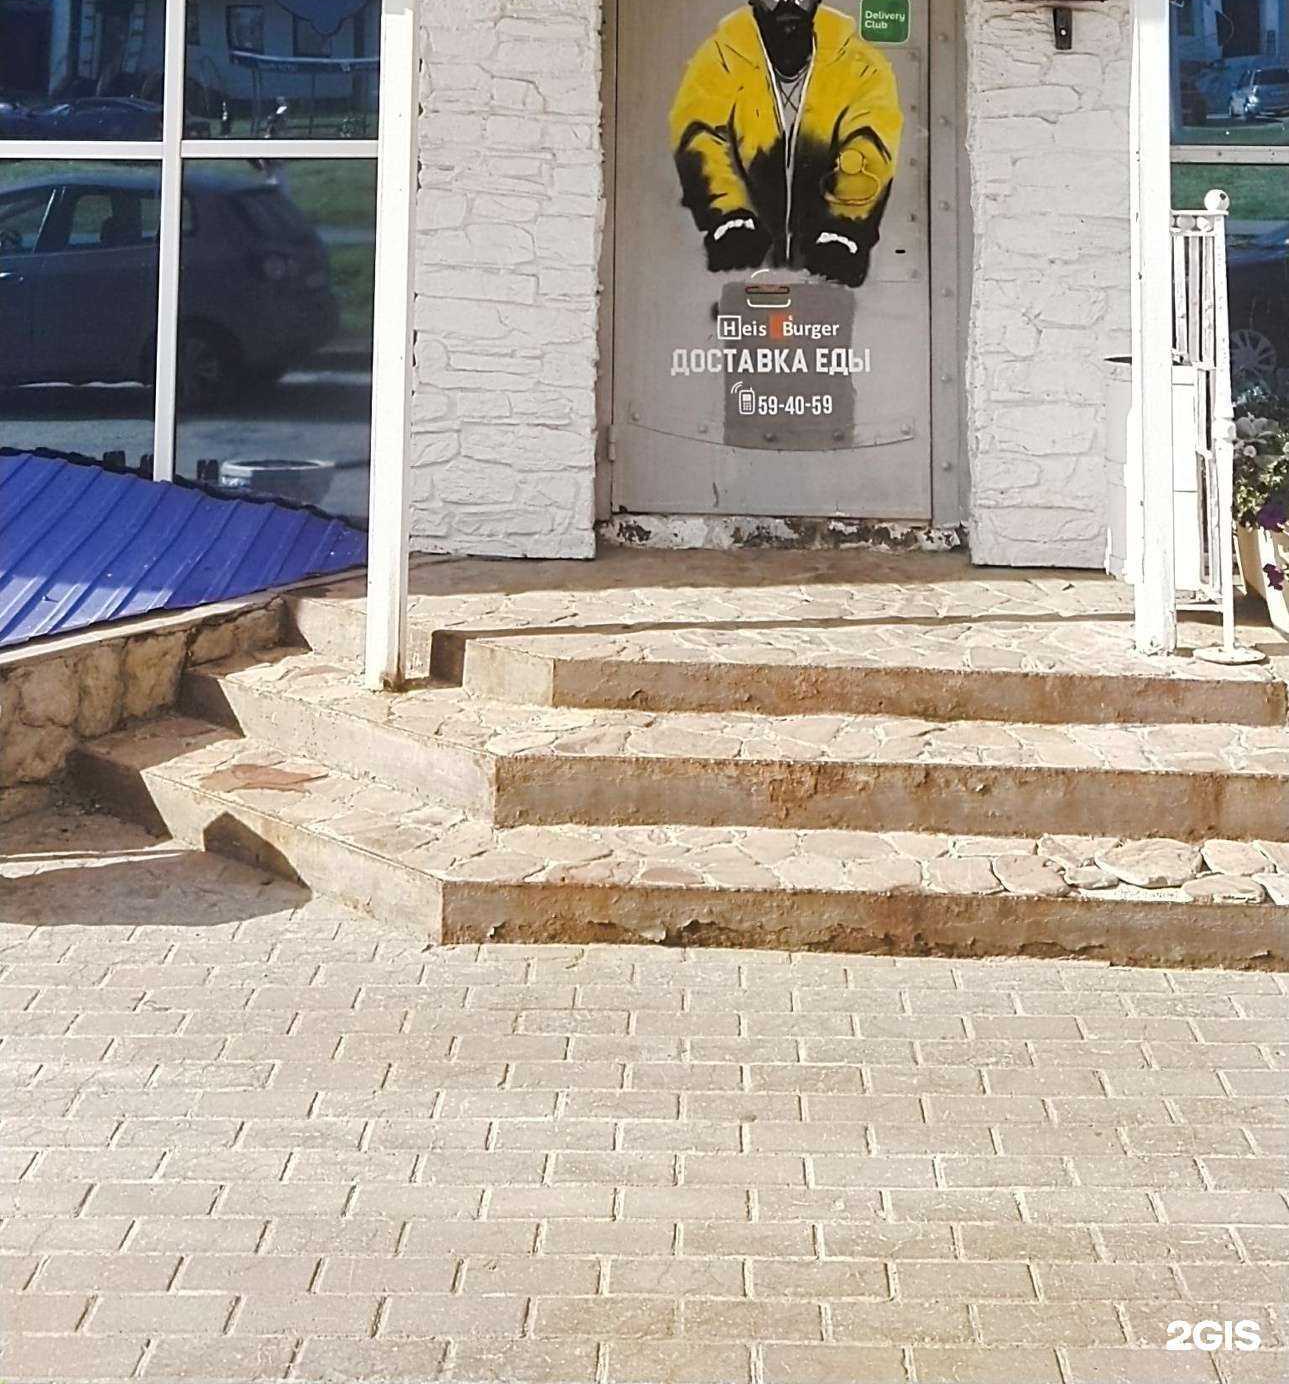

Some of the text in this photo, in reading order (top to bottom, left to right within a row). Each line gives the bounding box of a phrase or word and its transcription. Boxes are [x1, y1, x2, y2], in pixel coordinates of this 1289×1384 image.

[864, 10, 906, 23] Delivery
[864, 20, 888, 29] Club
[670, 348, 871, 377] ДОСТАВКА ЕДЫ
[758, 395, 833, 416] 59-40-59
